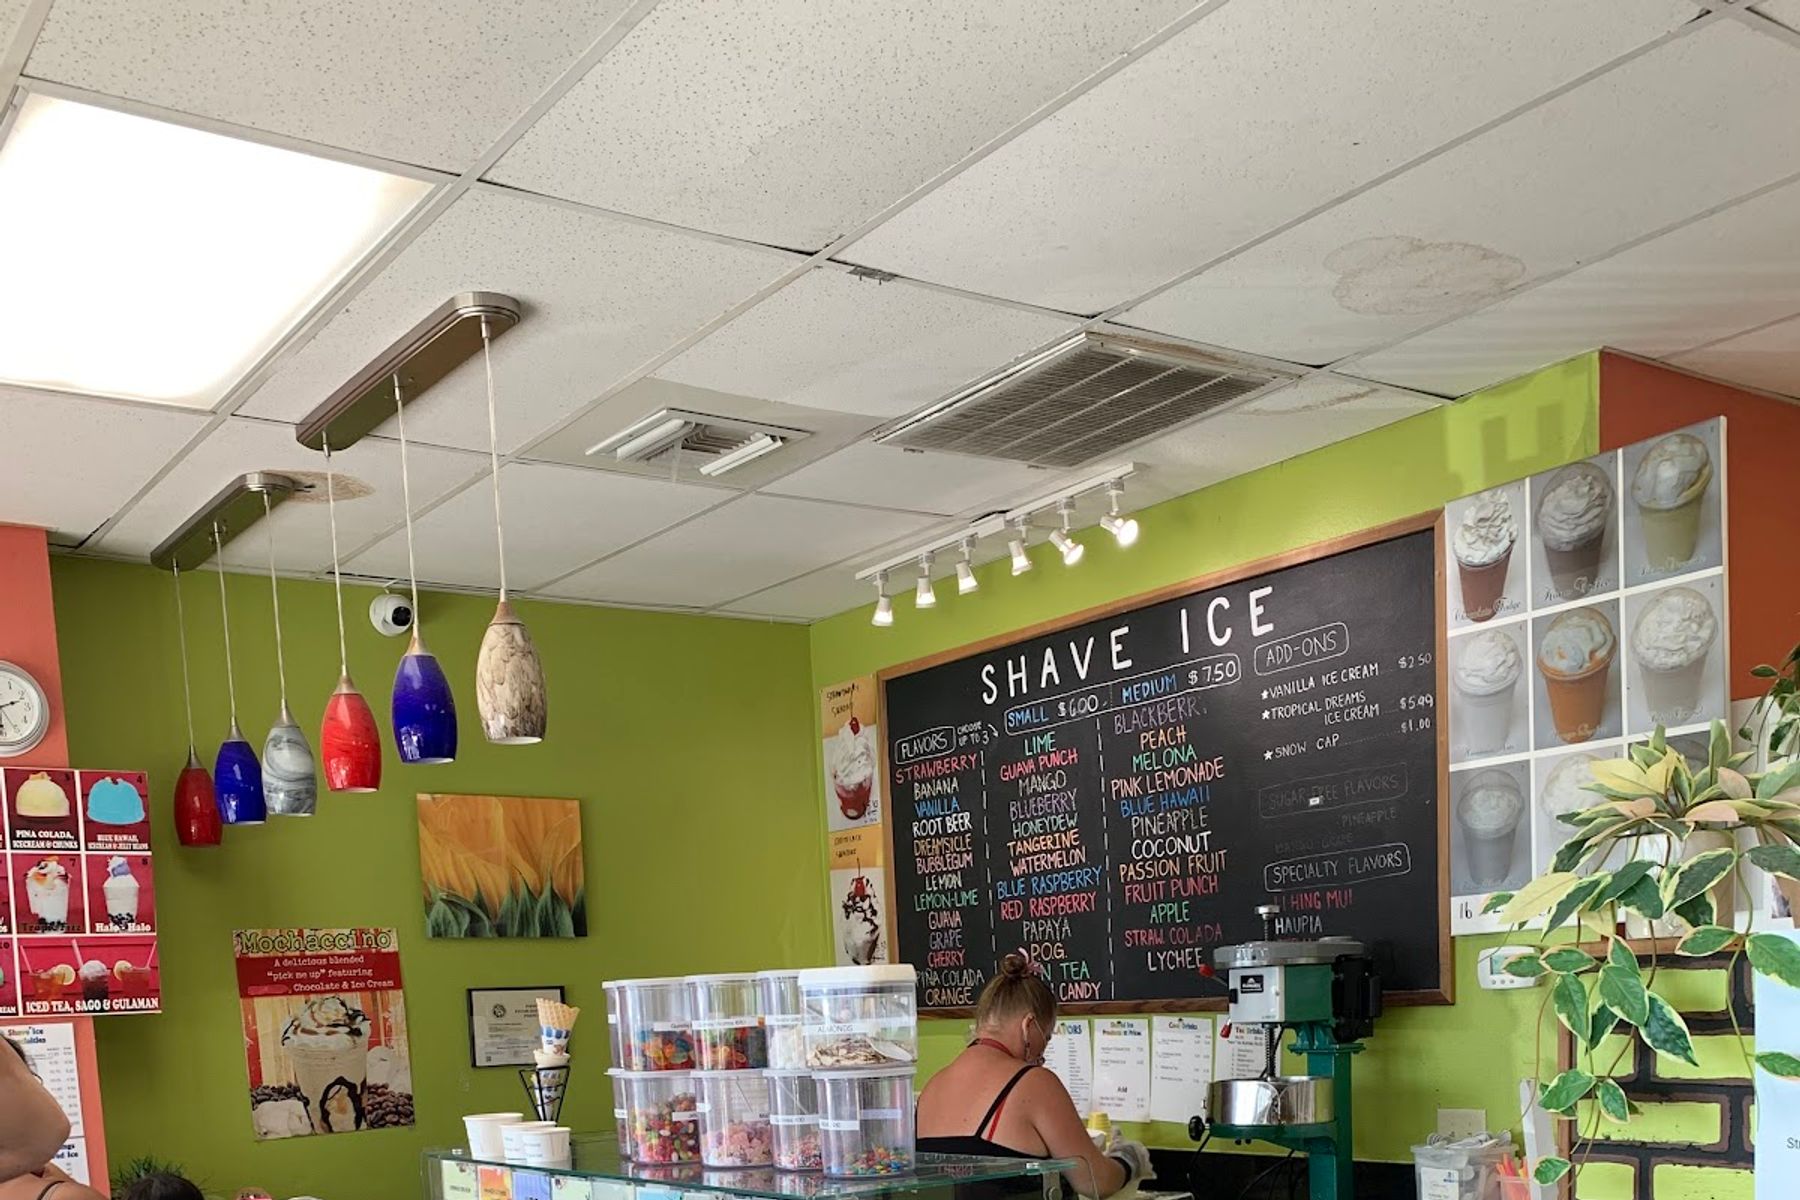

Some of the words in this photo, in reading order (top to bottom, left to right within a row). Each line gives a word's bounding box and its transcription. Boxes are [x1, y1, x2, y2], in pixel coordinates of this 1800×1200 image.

[981, 626, 1132, 705] SHAVE
[1180, 587, 1275, 654] ICE
[1266, 630, 1337, 667] ADD-ONS
[1269, 676, 1316, 699] VANILLA
[1322, 670, 1339, 687] ICE
[1340, 662, 1380, 682] CREAM
[1008, 706, 1049, 728] SMALL
[1122, 674, 1177, 704] MEDIUM
[1271, 701, 1322, 720] TROPICAL
[1325, 690, 1367, 711] DREAMS
[1114, 696, 1207, 735] BLACKBERR
[1324, 711, 1341, 726] ICE
[1344, 703, 1380, 721] CREAM
[902, 732, 948, 760] FLAVORS
[970, 732, 981, 744] TO
[982, 730, 989, 745] 3
[1024, 731, 1057, 756] LIME
[1140, 724, 1187, 751] PEACH
[1275, 741, 1307, 759] SNOW
[1316, 733, 1340, 750] CAP
[895, 753, 978, 784] STRAWBERRY
[1000, 758, 1036, 781] GUAVA
[1039, 748, 1079, 772] PUNCH
[1132, 744, 1197, 773] MELONA
[136, 775, 143, 784] 4
[914, 777, 960, 800] BANANA
[1018, 769, 1067, 797] MANGO
[1111, 775, 1143, 800] PINK
[1147, 756, 1225, 794] LEMONADE
[914, 796, 960, 818] VANILLA
[1009, 787, 1078, 821] BLUEBERRY
[1120, 794, 1155, 818] BLUE
[1160, 785, 1210, 811] HAWAII
[912, 817, 942, 838] ROOT
[946, 811, 973, 833] BEER
[1012, 812, 1078, 839] HONEYDEW
[1131, 805, 1208, 838] PINEAPPLE
[914, 833, 972, 857] DREAMSICLE
[1007, 828, 1080, 857] TANGERINE
[1131, 831, 1212, 860] COCONUT
[69, 857, 76, 867] 7
[915, 852, 974, 874] BUBBLEGUM
[1009, 845, 1086, 877] WATERMELON
[1120, 857, 1180, 883] PASSION
[1187, 849, 1227, 875] FRUIT
[1273, 860, 1339, 884] SPECIALTY
[1348, 850, 1402, 874] FLAVORS
[925, 871, 962, 891] LEMON
[996, 877, 1026, 900] BLUE
[1031, 865, 1102, 896] RASPBERRY
[1125, 880, 1166, 905] FRUIT
[1170, 874, 1218, 898] PUNCH
[914, 888, 979, 912] LEMON-LIME
[1000, 900, 1023, 921] RED
[1029, 891, 1098, 918] RASPBERRY
[1150, 901, 1191, 924] APPLE
[1290, 890, 1321, 910] HING
[95, 922, 119, 932] Halo
[127, 922, 151, 932] Halo
[928, 910, 962, 930] GUAVA
[1023, 917, 1072, 941] PAPAYA
[1274, 915, 1323, 934] HAUPIA
[240, 929, 392, 954] Mochaccino
[929, 929, 962, 950] GRAPE
[1169, 922, 1223, 945] COLADA
[274, 959, 281, 967] A
[282, 956, 327, 967] delicious
[329, 955, 364, 965] blended
[927, 949, 966, 968] CHERRY
[1059, 961, 1091, 980] TEA
[1147, 947, 1203, 972] LYCHEE
[293, 982, 340, 992] Chocolate
[341, 981, 349, 989] &
[350, 980, 365, 989] Ice
[366, 978, 395, 988] Cream
[295, 971, 308, 979] me
[328, 967, 374, 979] featuring
[942, 968, 985, 987] COLADA
[925, 986, 974, 1006] ORANGE
[1059, 981, 1101, 1001] CANDY
[26, 1001, 50, 1013] ICED
[51, 1000, 74, 1013] TEA,
[75, 1000, 100, 1011] SAGO
[103, 999, 110, 1010] &
[112, 998, 159, 1010] GULAMAN
